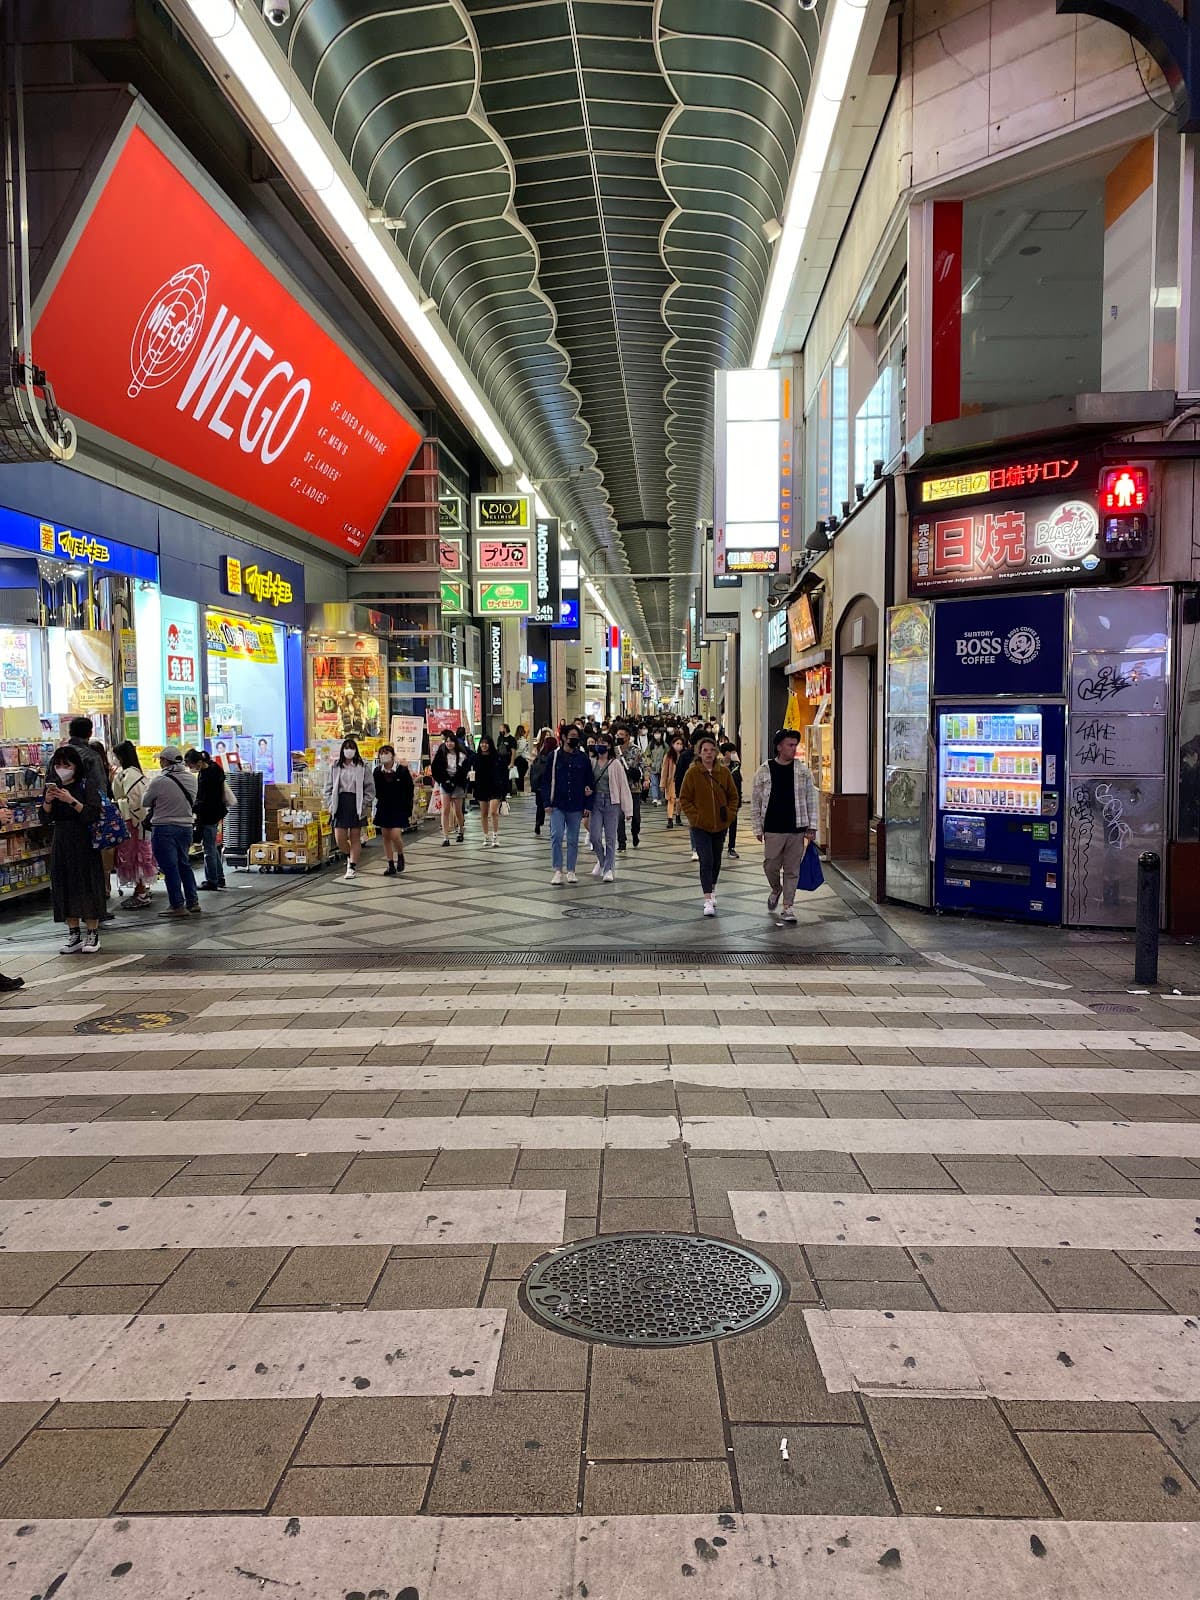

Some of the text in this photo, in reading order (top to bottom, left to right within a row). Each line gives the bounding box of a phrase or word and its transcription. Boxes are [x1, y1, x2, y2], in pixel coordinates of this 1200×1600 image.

[176, 304, 311, 465] WEGO
[363, 430, 388, 455] VINTAGE
[489, 503, 513, 514] DIO
[41, 524, 54, 551] 薬
[934, 511, 1026, 571] 日焼
[485, 547, 510, 562] プリ
[1030, 554, 1052, 566] 24h
[228, 560, 241, 594] 薬
[963, 630, 994, 638] SUNTORY
[955, 637, 1002, 656] BOSS
[961, 655, 996, 665] COFFEE
